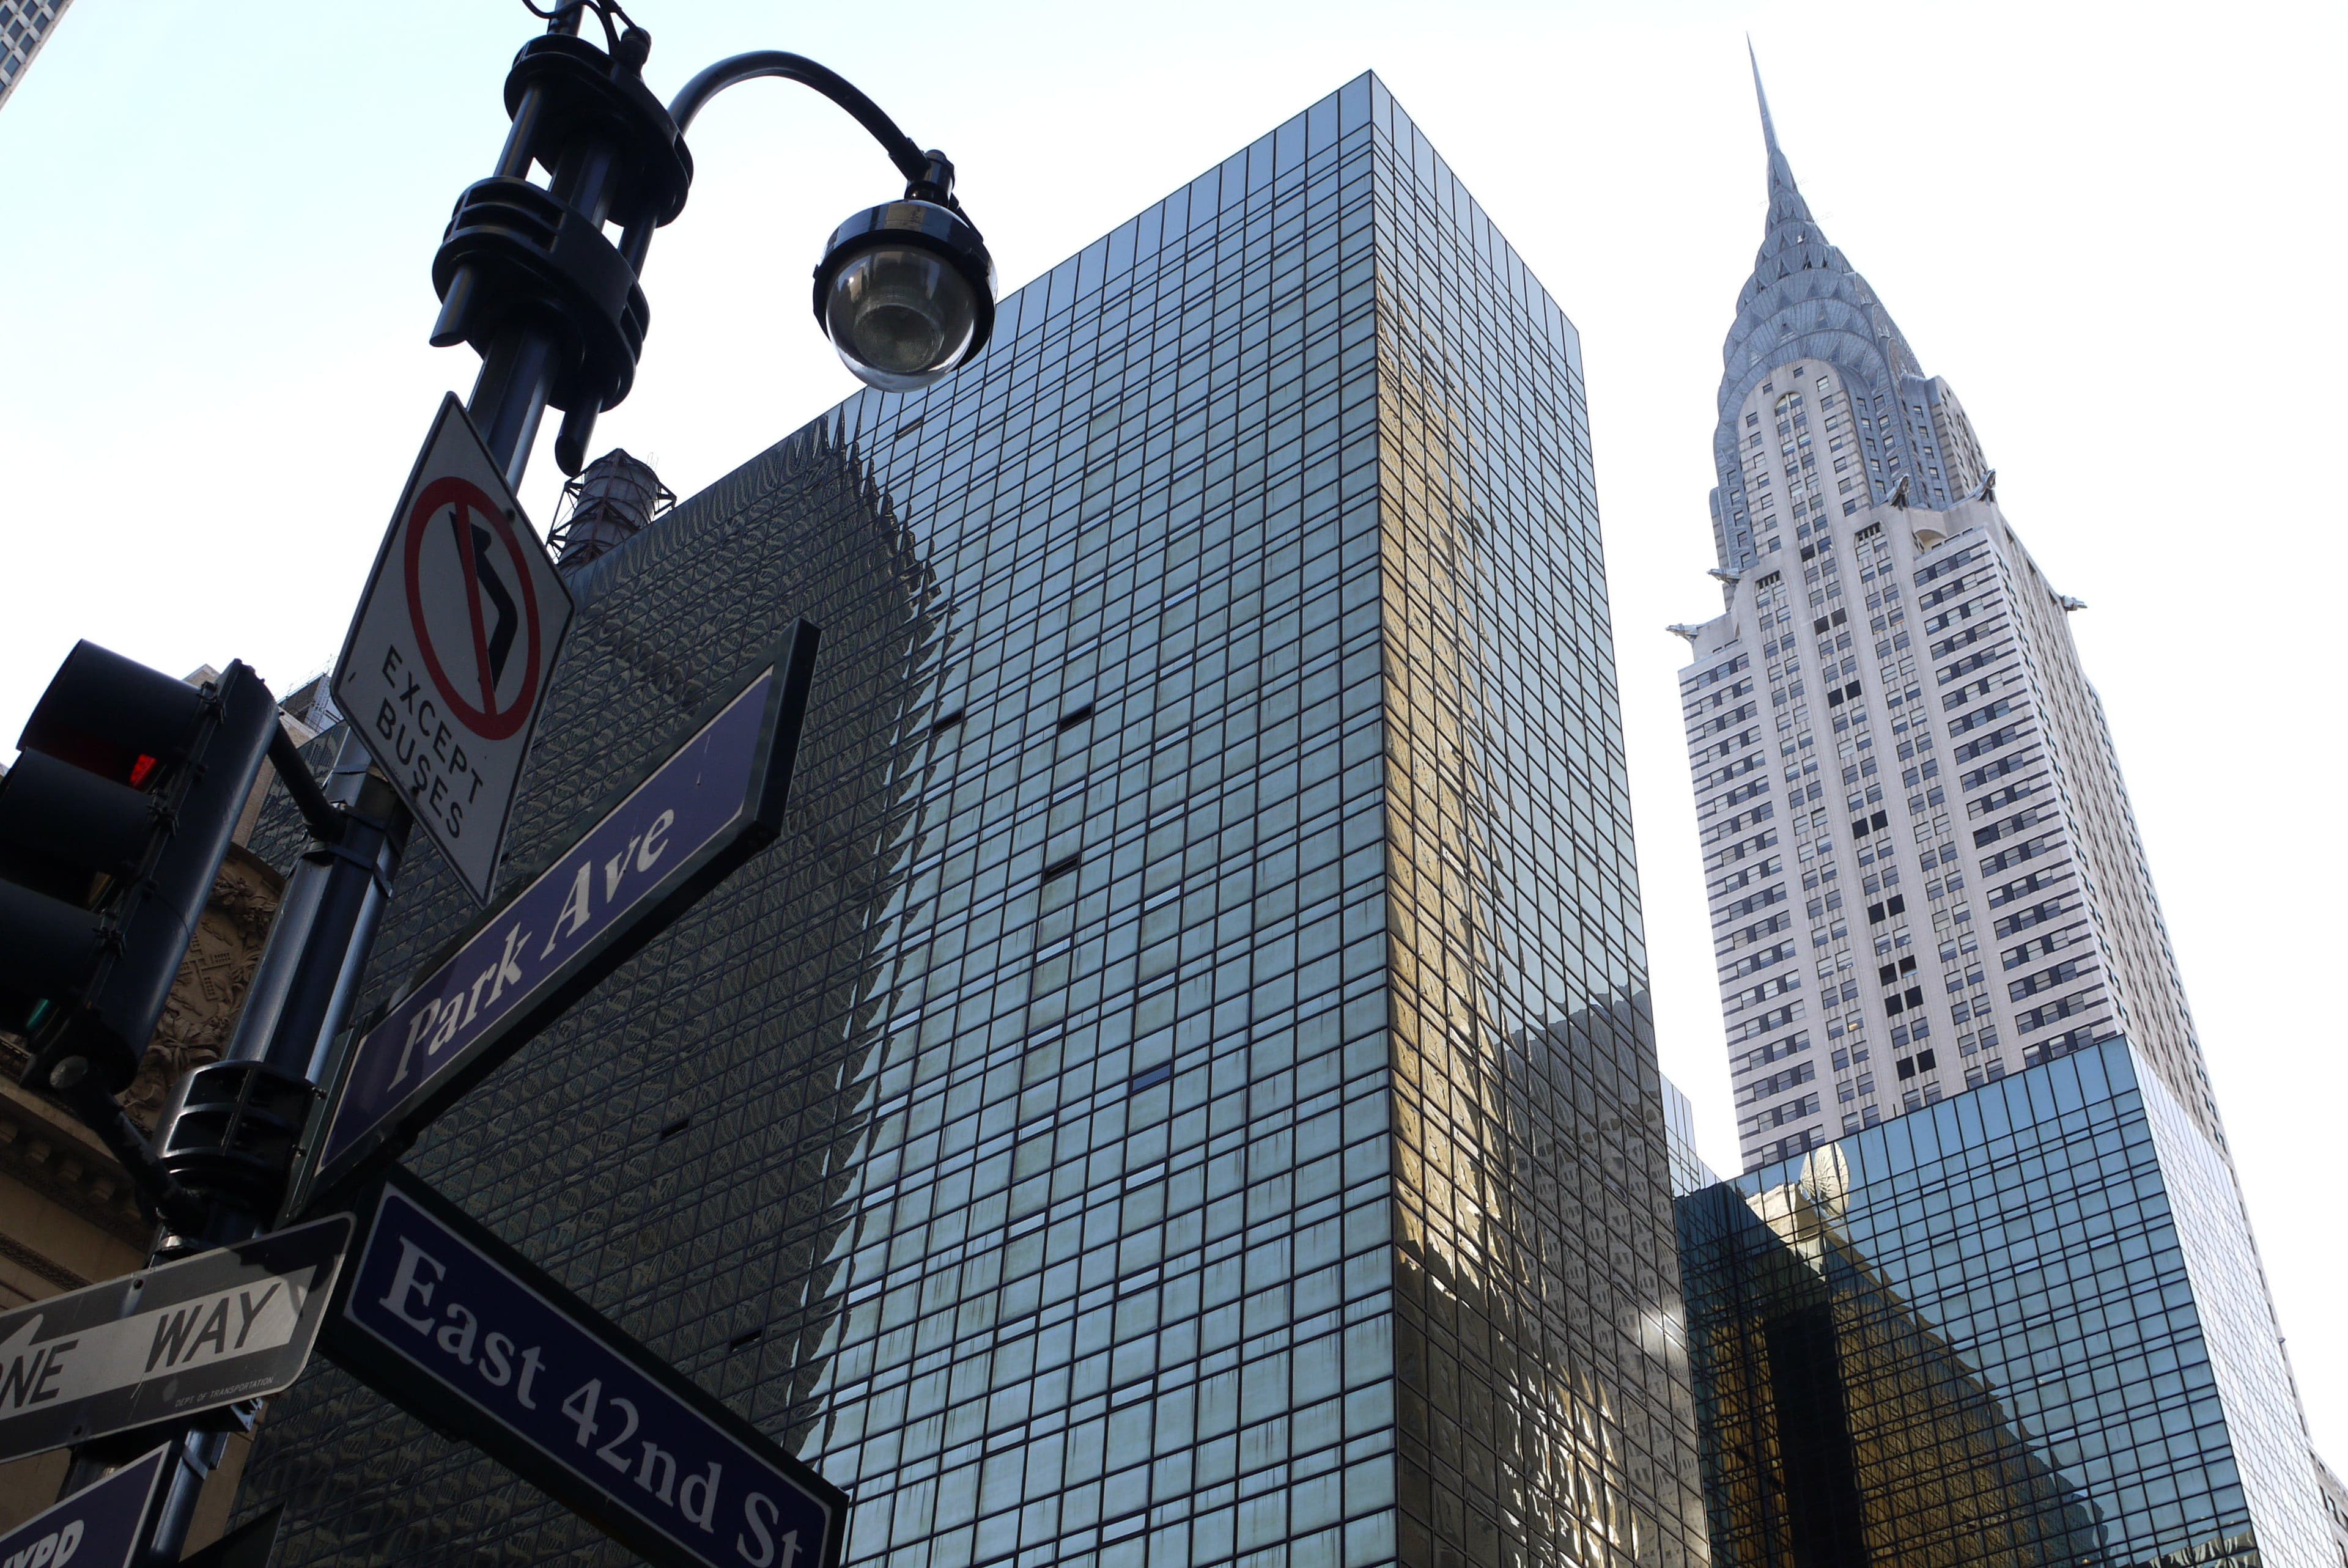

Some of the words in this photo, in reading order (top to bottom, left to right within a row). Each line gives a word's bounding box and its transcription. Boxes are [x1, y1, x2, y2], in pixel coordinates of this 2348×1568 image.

[376, 698, 462, 838] BUSES
[382, 645, 483, 804] EXCEPT
[388, 921, 531, 1091] Park
[540, 808, 674, 961] Ave
[0, 1339, 78, 1408] NE
[144, 1283, 282, 1373] WAY
[175, 1396, 194, 1407] DEPT
[197, 1393, 207, 1401] OF
[210, 1376, 274, 1399] TRANSPORTATION
[379, 1235, 545, 1410] East
[561, 1378, 722, 1534] 42nd
[737, 1492, 802, 1568] St
[2, 1519, 84, 1568] YPD
